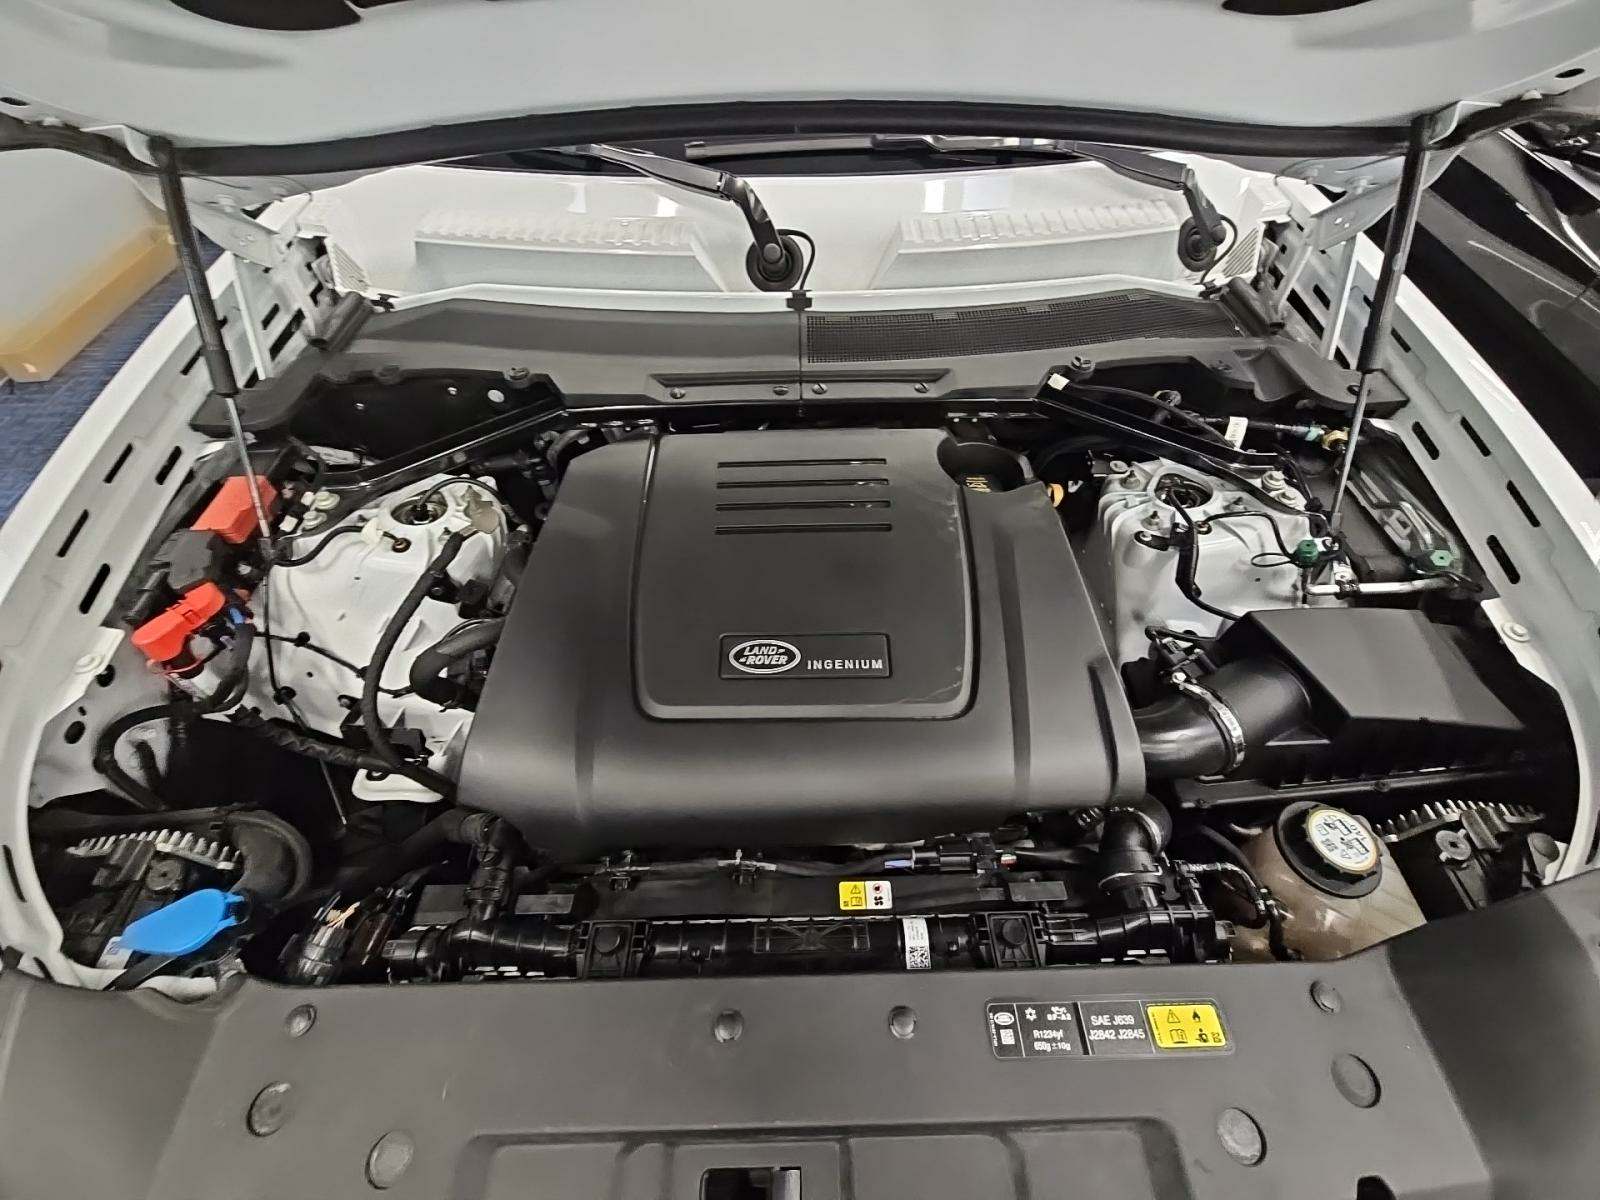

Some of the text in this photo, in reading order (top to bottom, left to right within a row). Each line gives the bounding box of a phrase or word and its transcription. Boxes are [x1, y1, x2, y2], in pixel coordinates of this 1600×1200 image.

[743, 646, 779, 655] LAND
[744, 655, 788, 665] ROVER
[807, 659, 883, 670] INGENIUM
[1090, 1014, 1135, 1026] SAE J639
[1089, 1028, 1146, 1041] J2842 J2845
